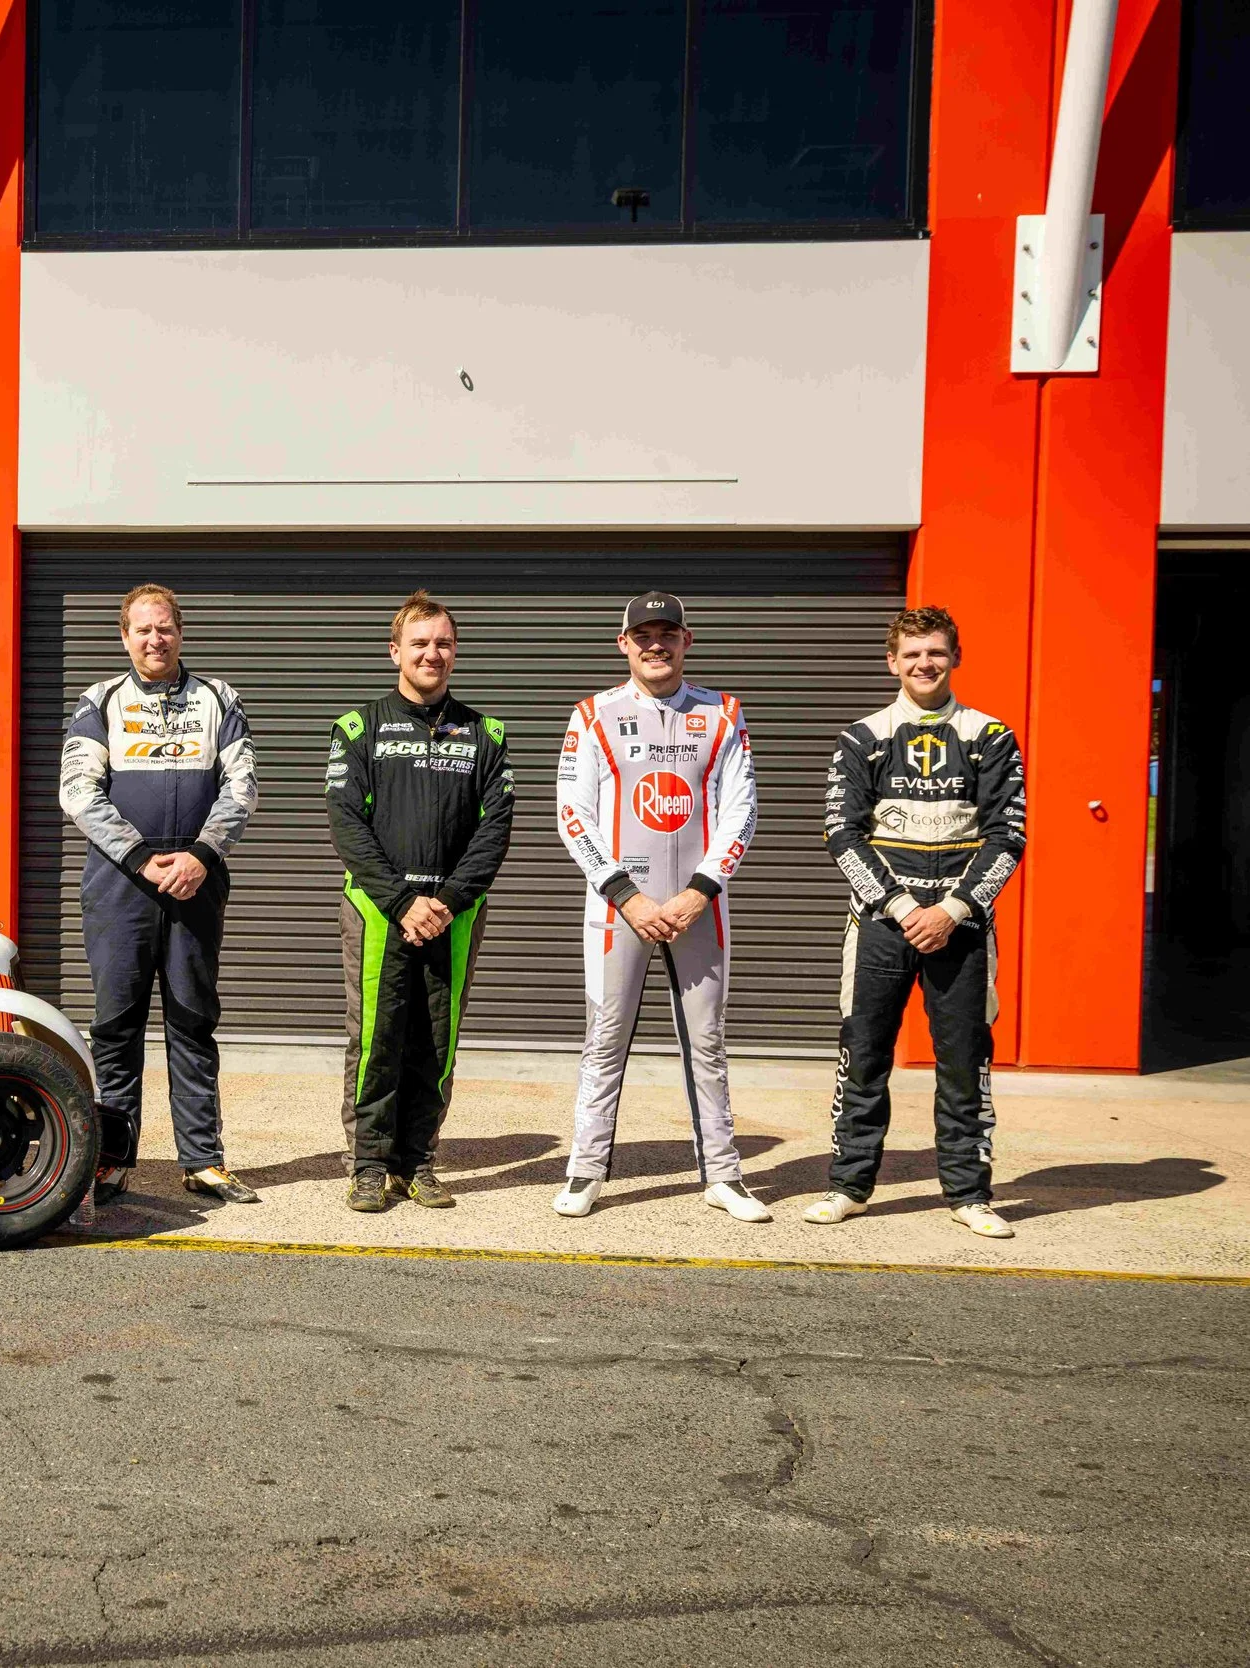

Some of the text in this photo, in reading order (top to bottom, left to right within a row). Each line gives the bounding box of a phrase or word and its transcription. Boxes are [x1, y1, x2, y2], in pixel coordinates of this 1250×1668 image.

[617, 714, 638, 722] Mobil
[649, 744, 698, 753] PRISTINE
[649, 753, 698, 762] AUCTION
[891, 776, 965, 790] EVOLVE
[639, 772, 692, 823] Rheem
[845, 852, 885, 897] PERFORMANCE
